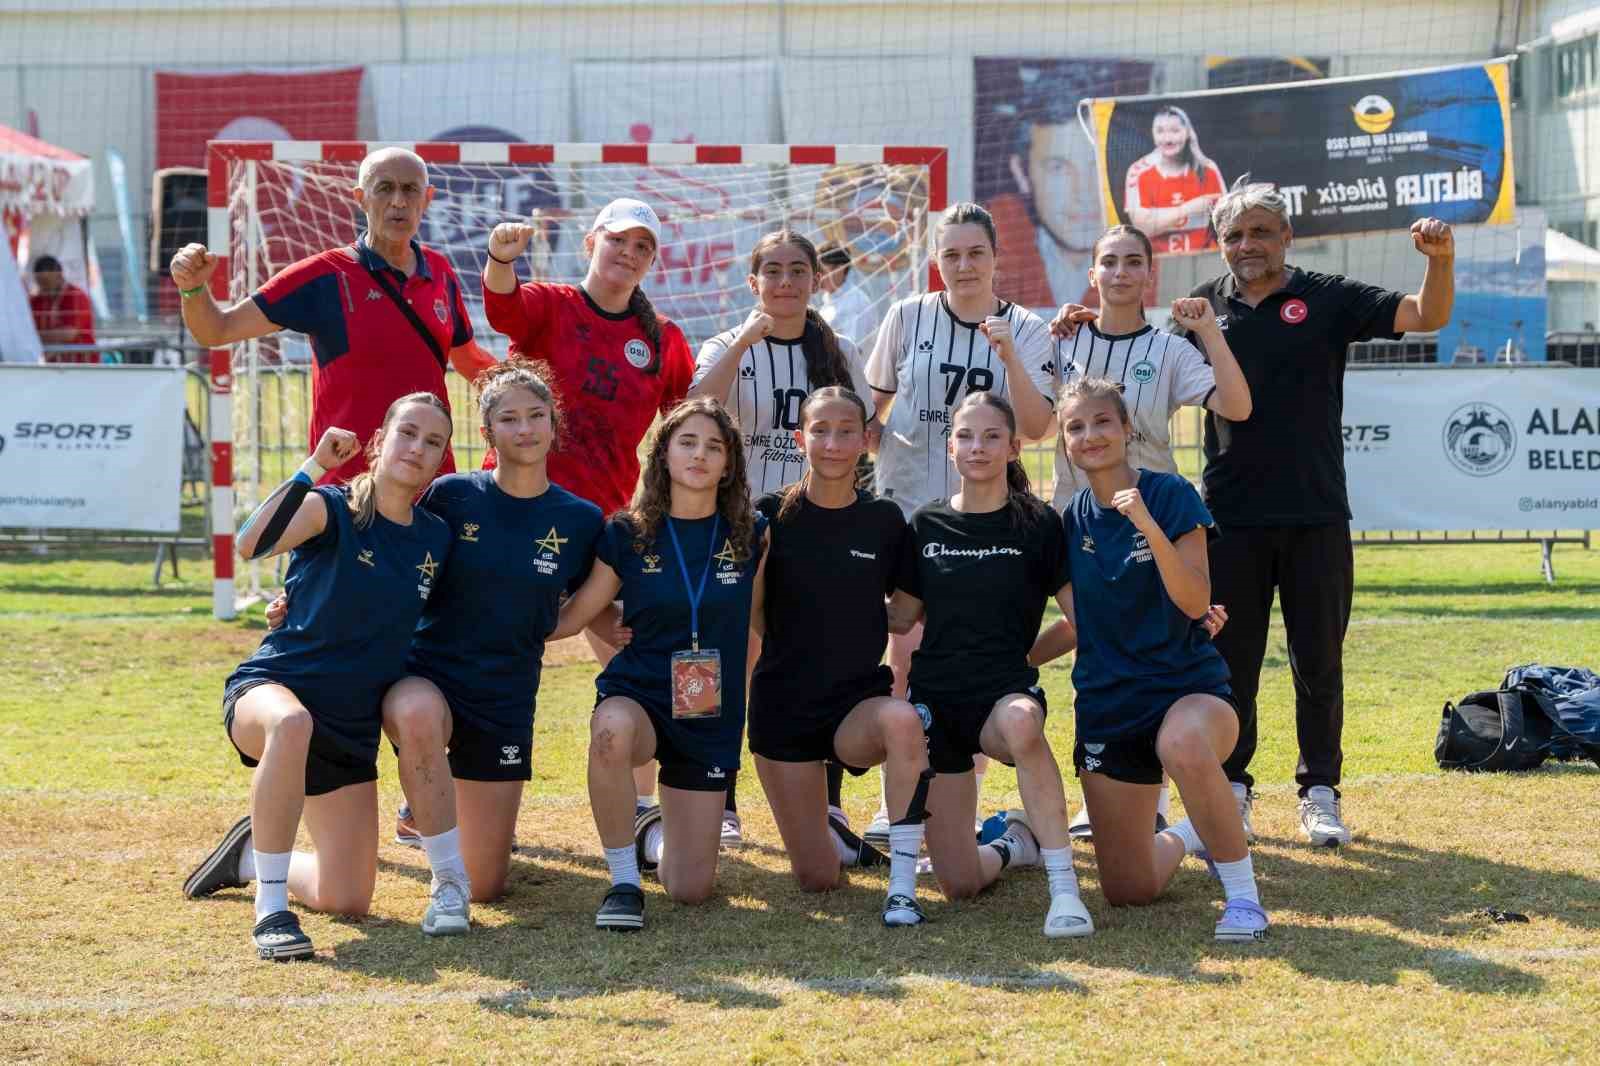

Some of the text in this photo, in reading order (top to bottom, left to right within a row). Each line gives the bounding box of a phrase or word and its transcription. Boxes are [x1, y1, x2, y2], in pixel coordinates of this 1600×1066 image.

[772, 388, 808, 430] 10
[14, 422, 133, 440] SPORTS
[1342, 424, 1391, 441] RTS
[760, 448, 806, 463] Fitness
[922, 542, 1024, 559] Champion
